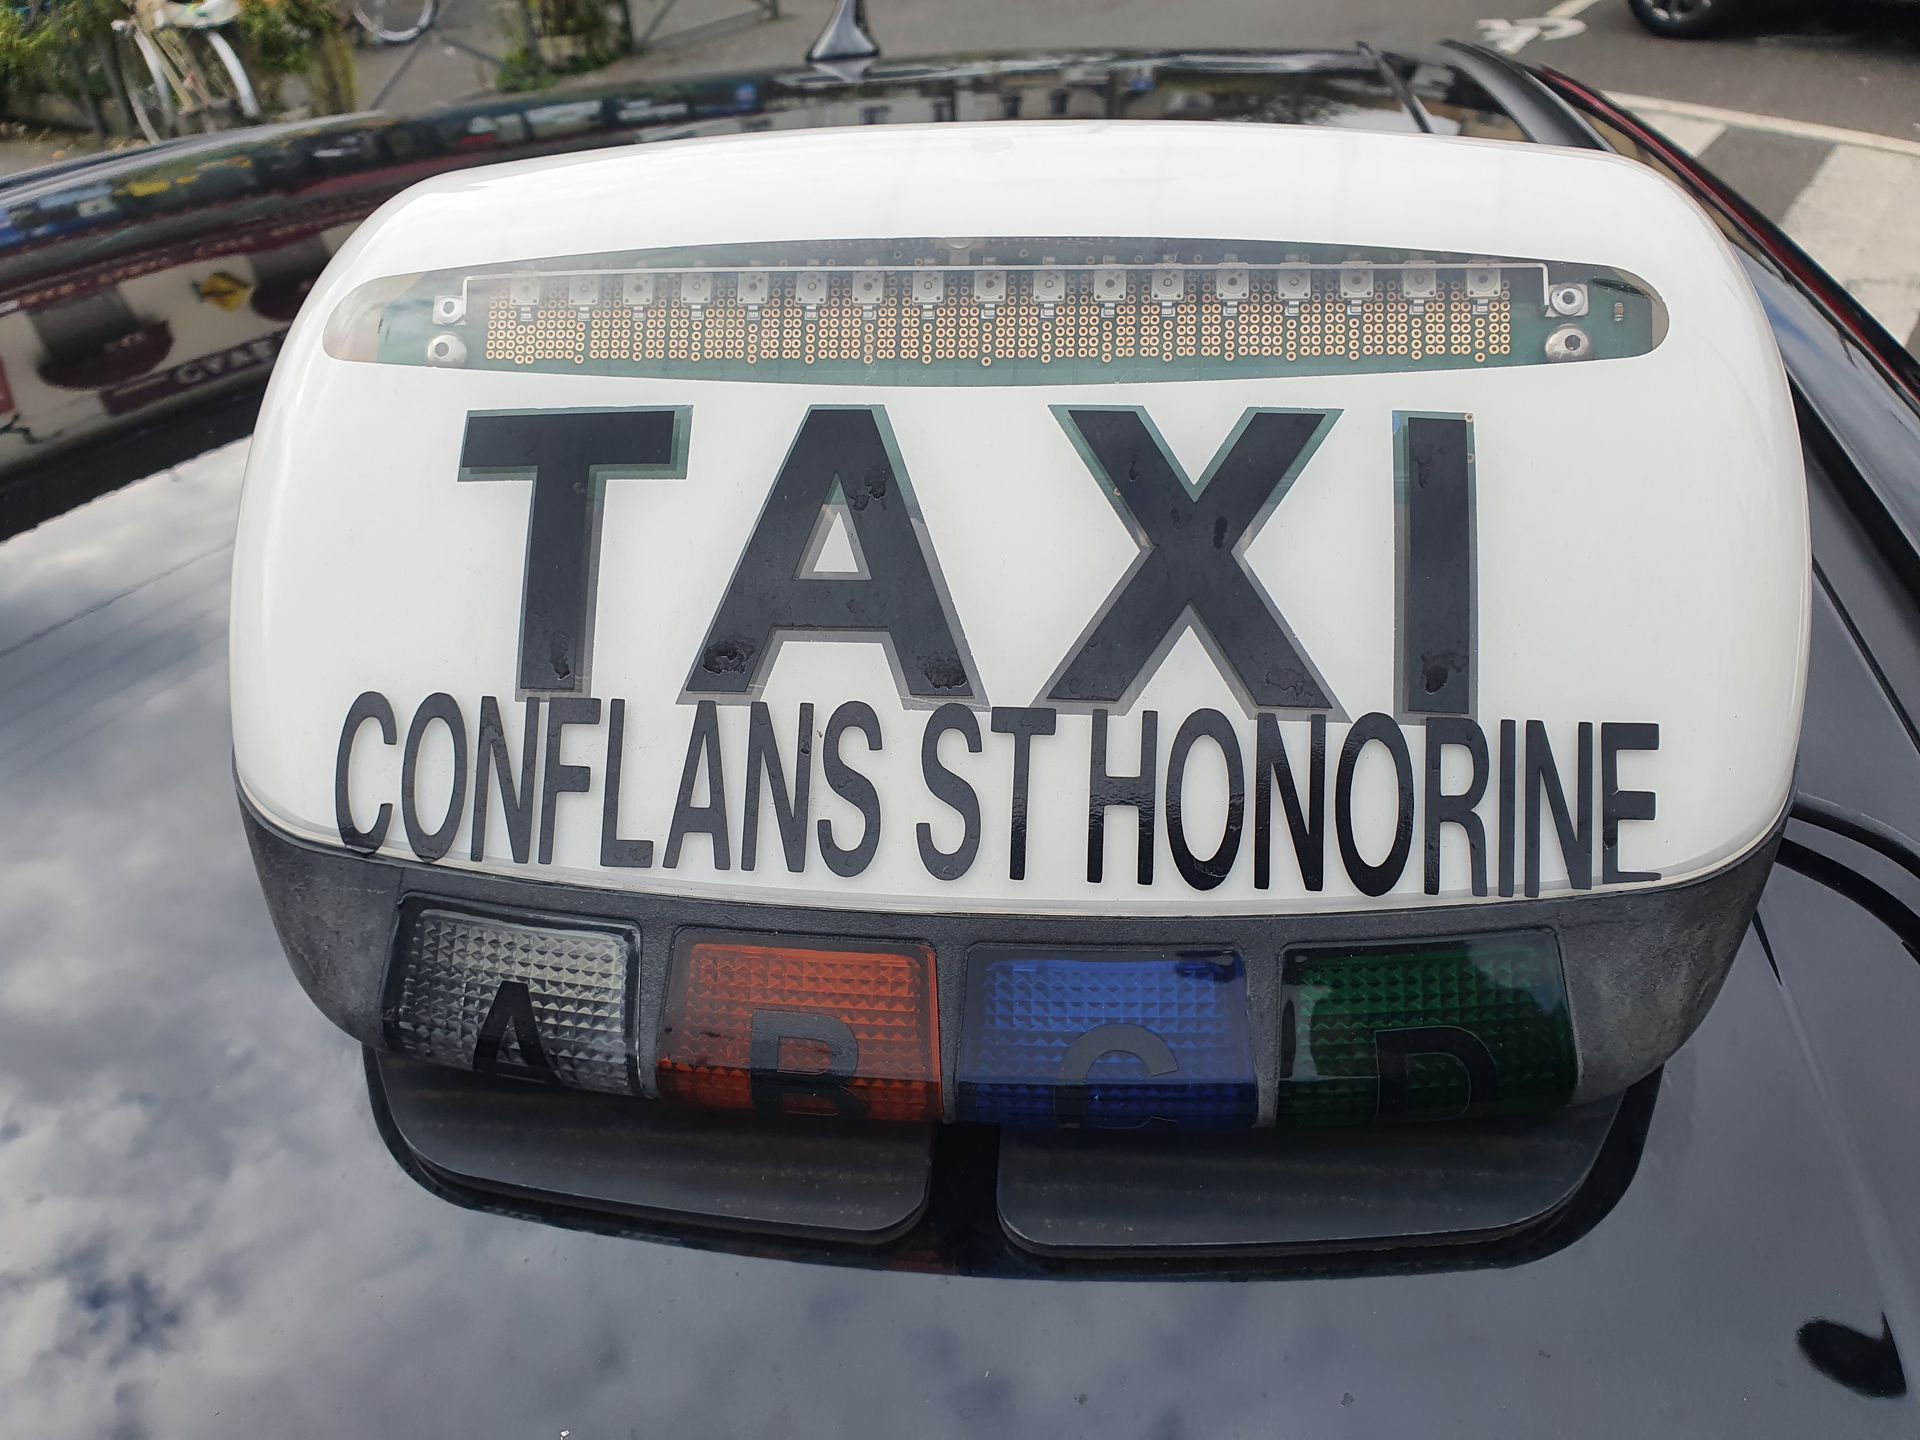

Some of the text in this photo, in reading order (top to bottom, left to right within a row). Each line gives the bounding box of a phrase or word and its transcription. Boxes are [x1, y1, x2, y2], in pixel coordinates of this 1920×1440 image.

[458, 404, 1477, 720] TAXI
[335, 690, 1663, 898] CONFLANS ST HONORINE
[471, 981, 564, 1085] A
[750, 1008, 868, 1122] B
[1053, 1022, 1179, 1130] C
[1374, 1025, 1501, 1121] D
